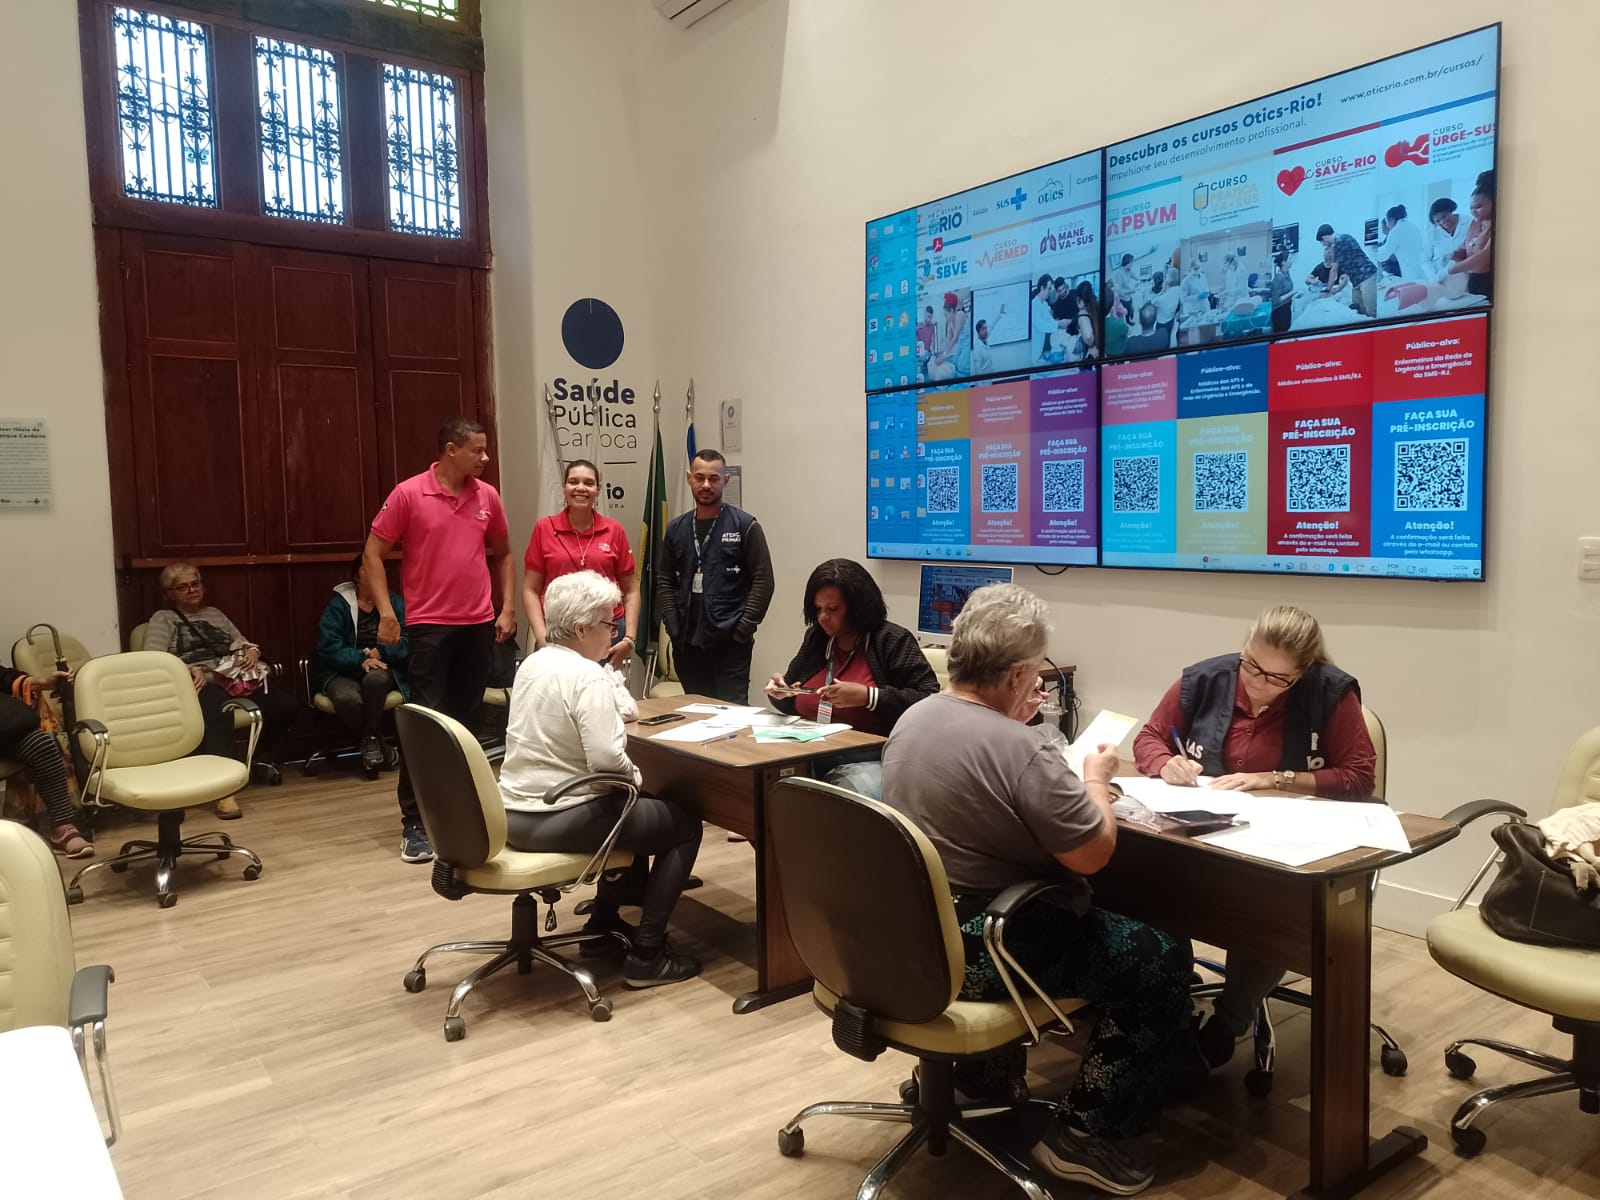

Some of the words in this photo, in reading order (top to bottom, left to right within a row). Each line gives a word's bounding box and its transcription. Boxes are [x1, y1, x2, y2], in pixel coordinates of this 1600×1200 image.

[1340, 55, 1484, 104] www.oticsrio.com.br/cursos/
[1109, 140, 1168, 168] Descubra
[1171, 138, 1187, 149] os
[1191, 122, 1238, 144] cursos
[1242, 91, 1322, 128] Otics-Rio!
[1432, 122, 1463, 135] CURSO
[1109, 163, 1151, 182] Impulsione
[1153, 157, 1168, 168] seu
[1170, 138, 1245, 162] desenvolvimento
[1248, 119, 1306, 144] profissional.
[1314, 154, 1376, 177] SAVE-RIO
[1315, 156, 1342, 167] CURSO
[1076, 175, 1098, 185] Cursos
[1210, 174, 1248, 191] CURSO
[1122, 201, 1151, 215] CURSO
[939, 212, 963, 233] RIO
[1121, 203, 1177, 234] PBVM
[1058, 227, 1085, 243] MANE
[1058, 234, 1094, 250] VA-SUS
[936, 260, 968, 280] SBVE
[1406, 338, 1460, 350] Público-alvo:
[1295, 361, 1343, 371] Público-alvo:
[553, 377, 635, 405] Saúde
[553, 404, 637, 429] Pública
[1404, 410, 1433, 422] FAÇA
[1435, 409, 1457, 418] SUA
[1295, 419, 1320, 430] FAÇA
[1321, 418, 1341, 426] SUA
[1390, 419, 1475, 434] PRÉ-INSCRIÇÃO
[556, 427, 638, 449] Caroca
[1282, 427, 1355, 440] PRÉ-INSCRIÇÃO
[1047, 439, 1065, 448] FAÇA
[1049, 519, 1078, 528] Atenção!
[1295, 521, 1339, 532] Atenção!
[1405, 521, 1455, 533] Atenção!
[1396, 534, 1435, 543] confirmação
[1418, 541, 1441, 549] e-mail
